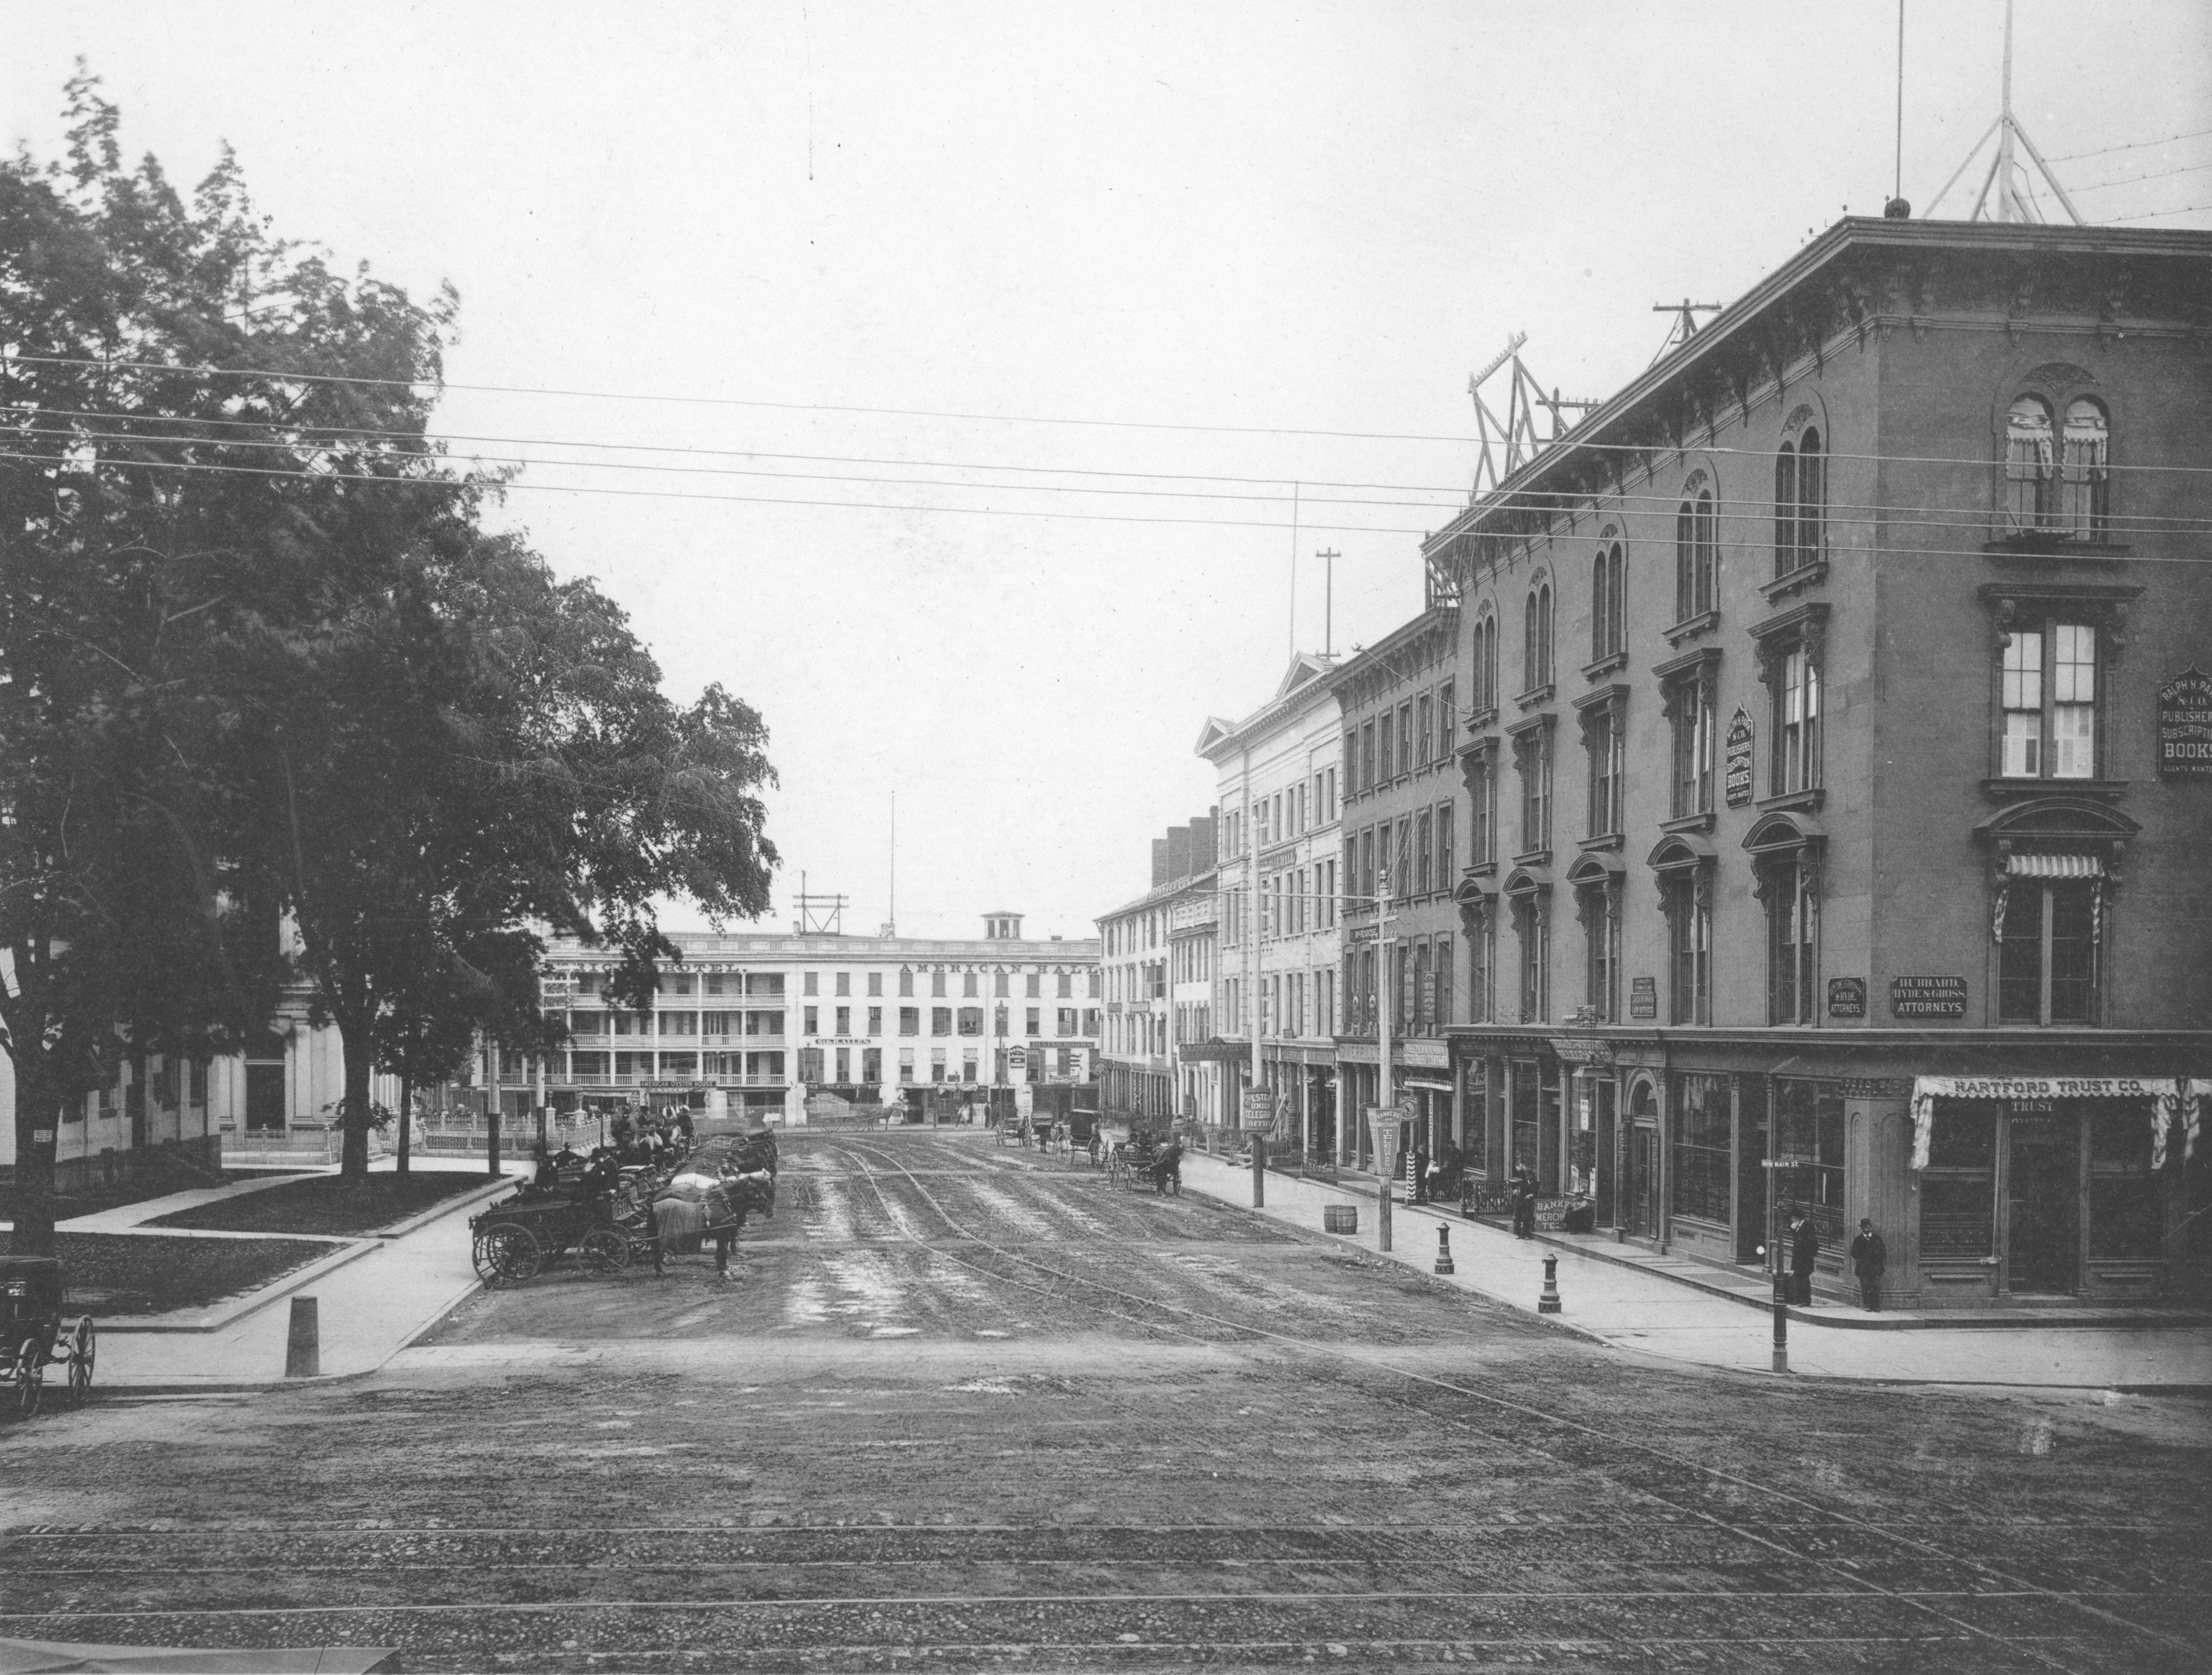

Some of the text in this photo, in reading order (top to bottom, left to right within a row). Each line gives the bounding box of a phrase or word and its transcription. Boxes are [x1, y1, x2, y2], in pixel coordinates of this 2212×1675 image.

[2162, 680, 2188, 701] RALPH
[900, 963, 1022, 973] AMERICAN
[1894, 989, 1967, 998] HYDE & GROSS.
[1898, 1002, 1964, 1013] ATTORNEYS.
[1954, 1079, 2145, 1094] HARTFORD TRUST CO.
[2011, 1101, 2054, 1112] TRUST
[1376, 1111, 1401, 1120] BANKERS
